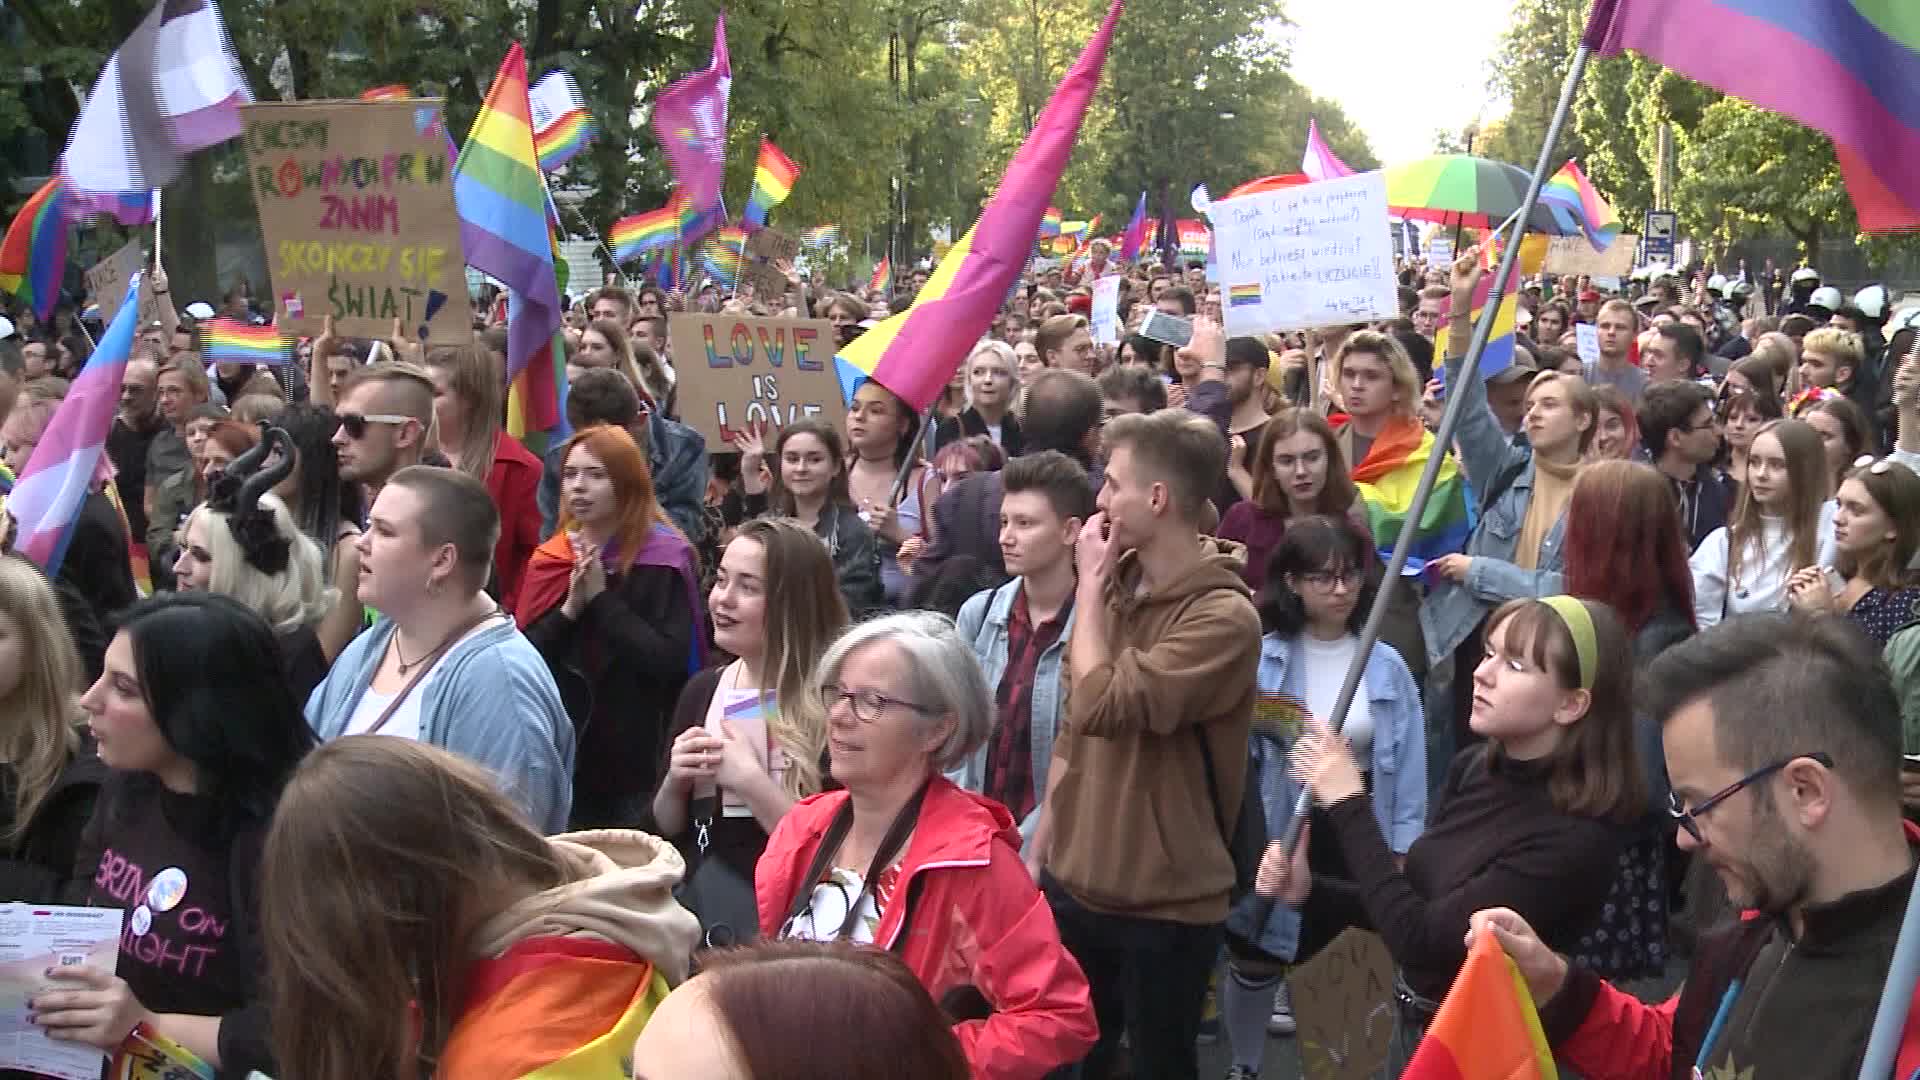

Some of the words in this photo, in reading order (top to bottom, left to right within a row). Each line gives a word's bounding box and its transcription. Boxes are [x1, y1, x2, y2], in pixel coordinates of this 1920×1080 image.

[320, 195, 400, 235] ZANIM
[703, 322, 825, 372] LOVE
[752, 373, 780, 400] IS
[96, 848, 160, 915] BRIN
[179, 906, 225, 938] ON
